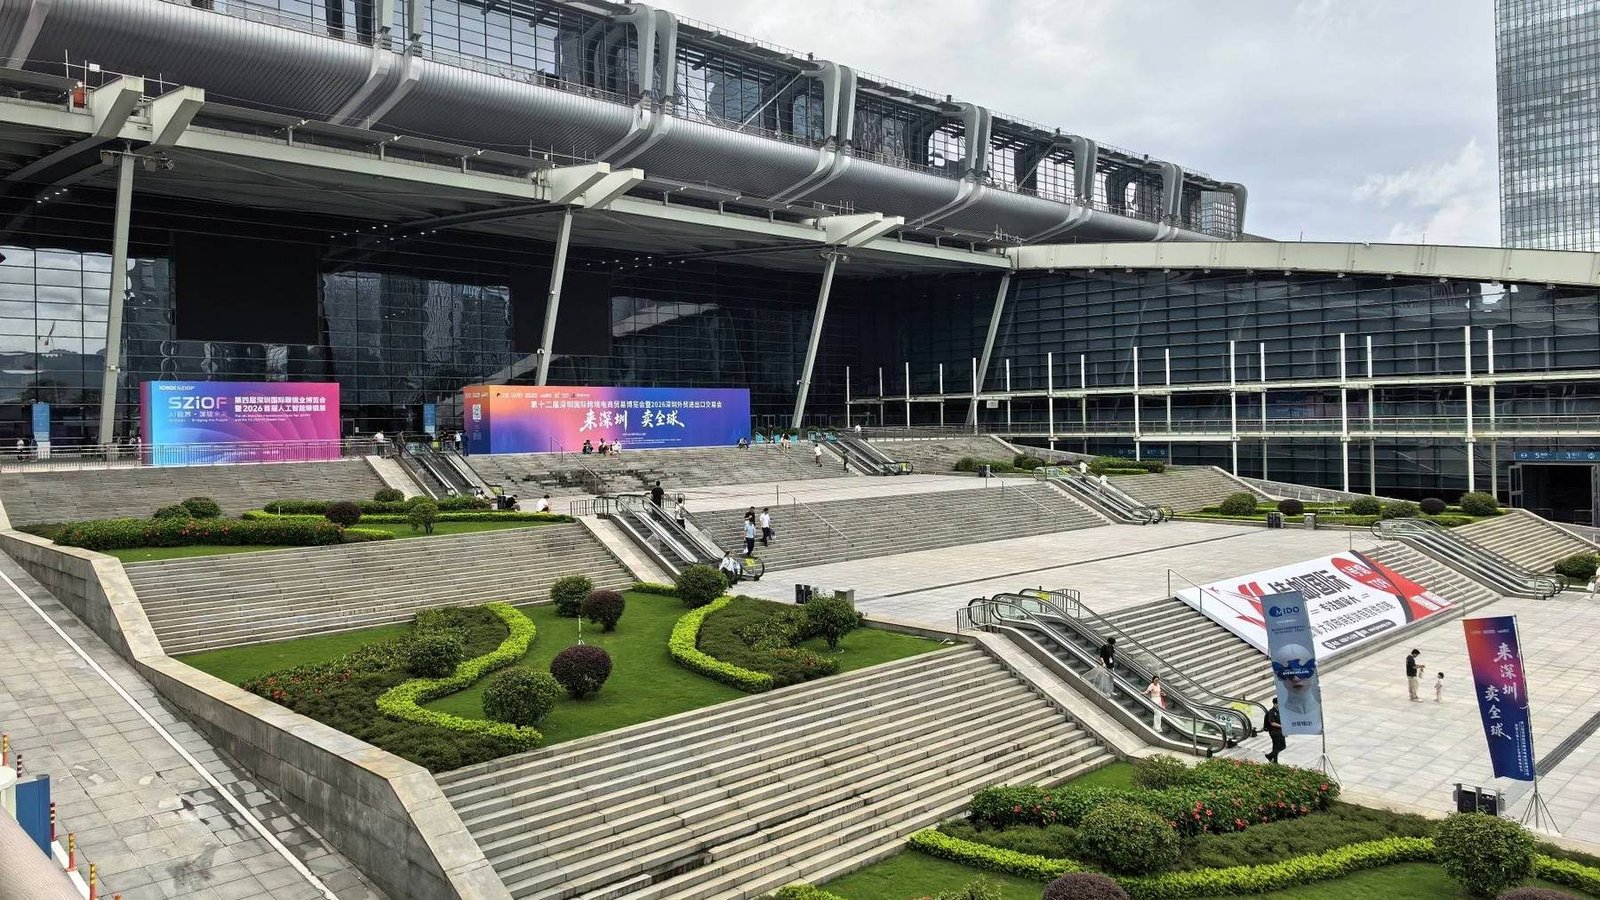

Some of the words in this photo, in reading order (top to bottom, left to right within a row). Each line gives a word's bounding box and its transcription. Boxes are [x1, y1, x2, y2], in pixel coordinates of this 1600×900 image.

[579, 410, 628, 432] 来深圳
[641, 409, 685, 428] 卖全球
[1493, 642, 1518, 701] 来深圳
[1484, 685, 1512, 740] 卖全球
